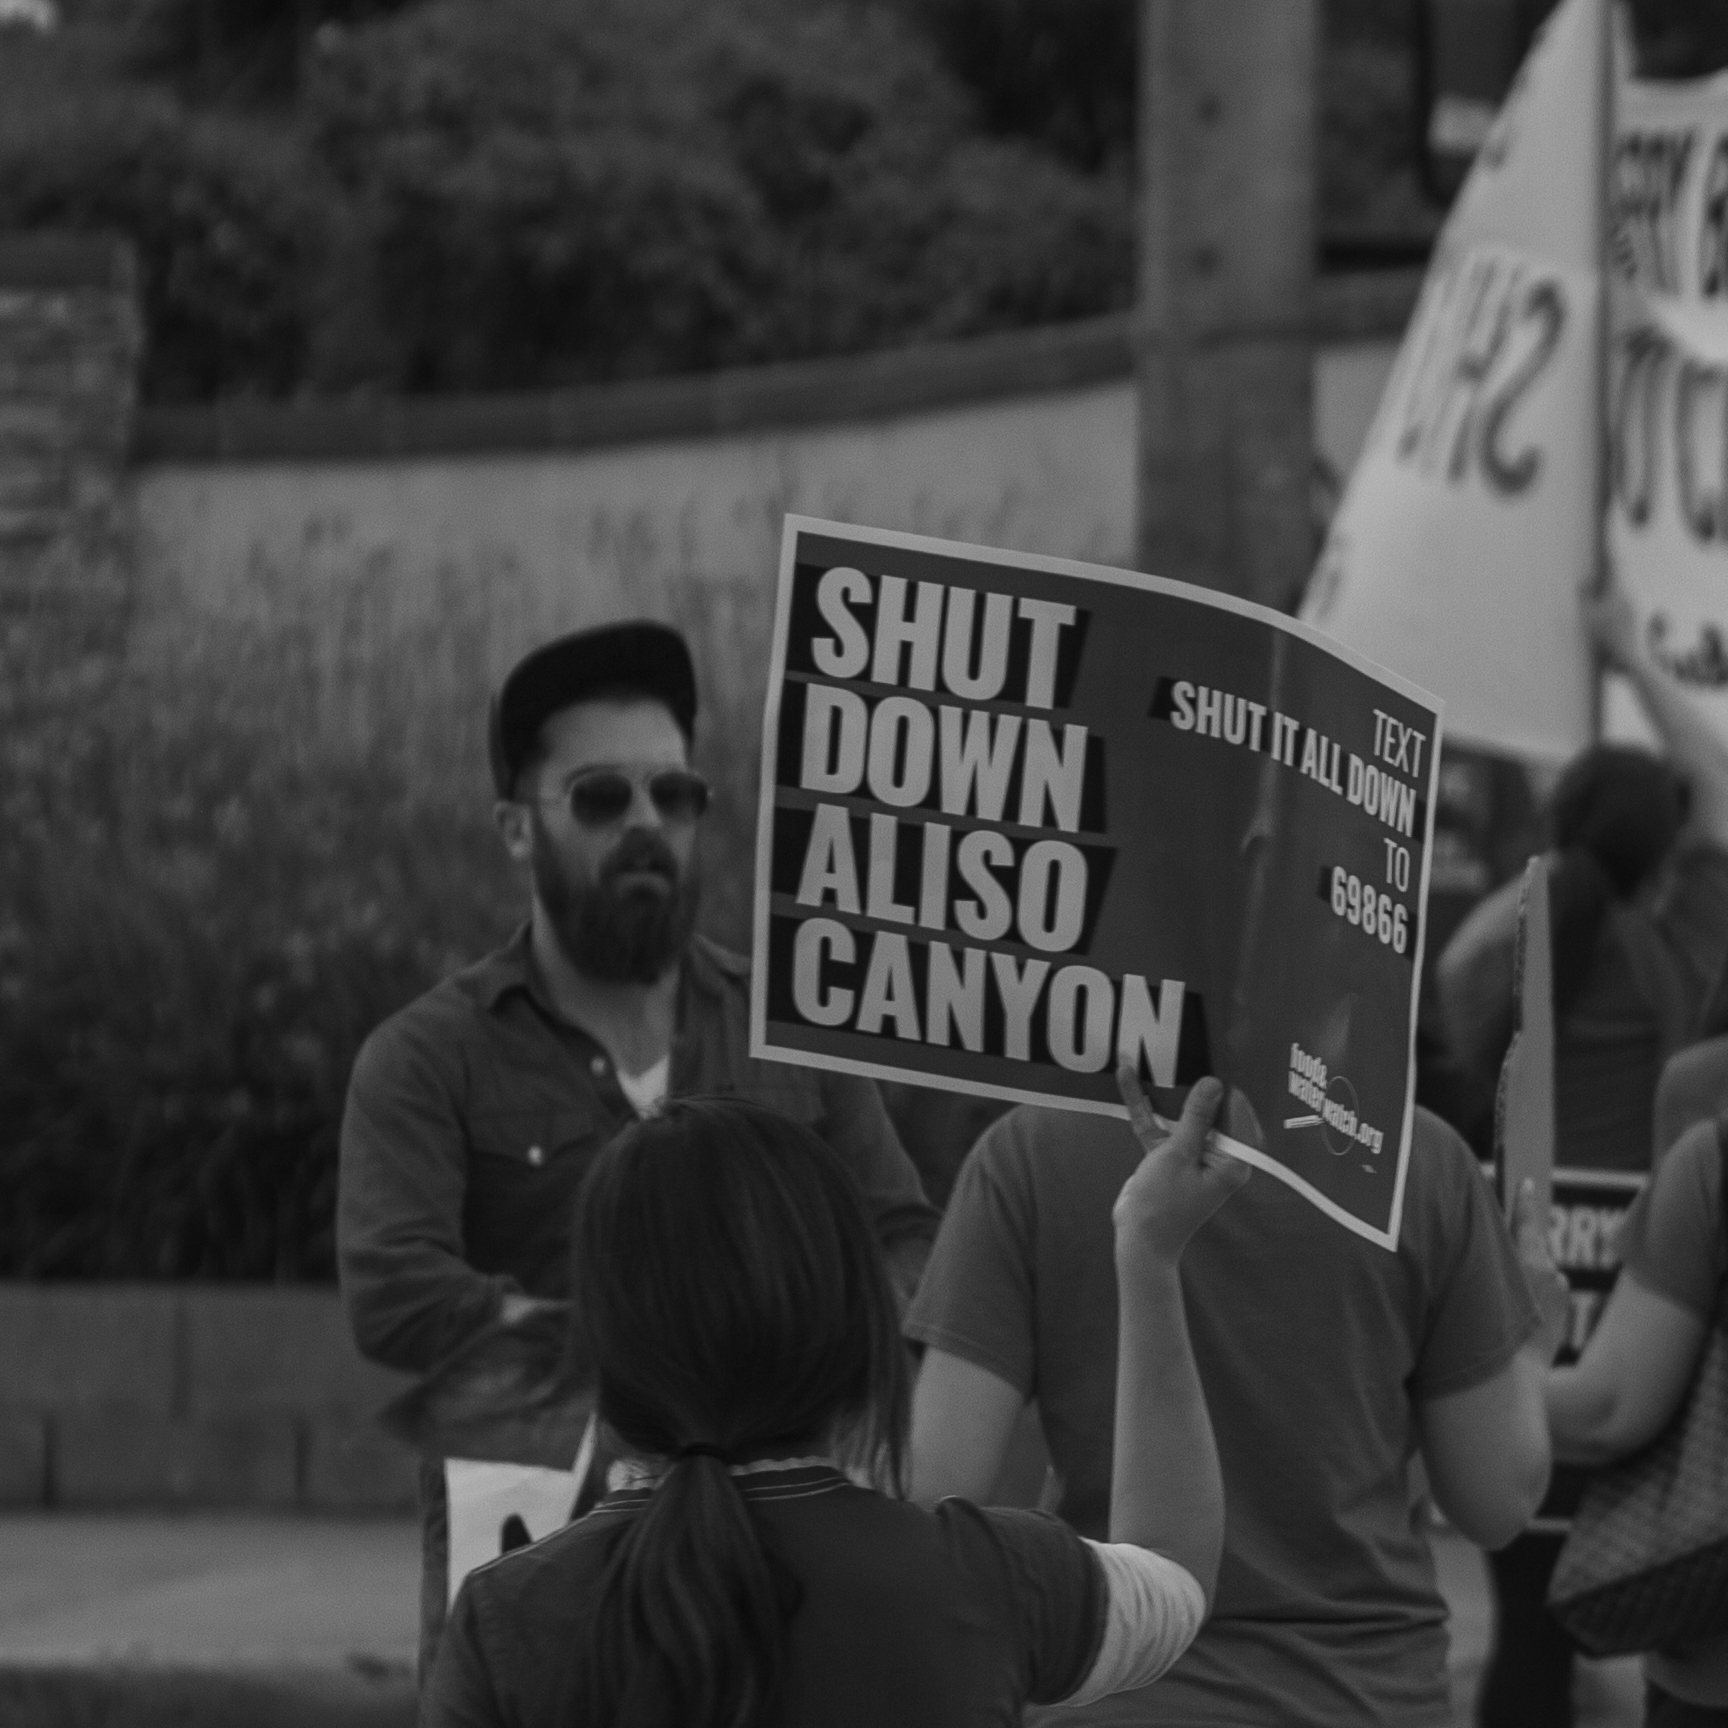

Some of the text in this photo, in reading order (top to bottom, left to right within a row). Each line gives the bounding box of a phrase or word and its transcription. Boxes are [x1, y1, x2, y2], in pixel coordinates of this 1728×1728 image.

[811, 567, 1077, 709] SHUT
[801, 682, 1088, 833] DOWN
[1170, 680, 1417, 837] SHUT IT ALL DOWN
[1373, 708, 1427, 778] TEXT
[796, 803, 1088, 953] ALISO
[1331, 865, 1408, 954] 69866
[1384, 837, 1411, 893] TO
[792, 917, 1186, 1089] CANYON
